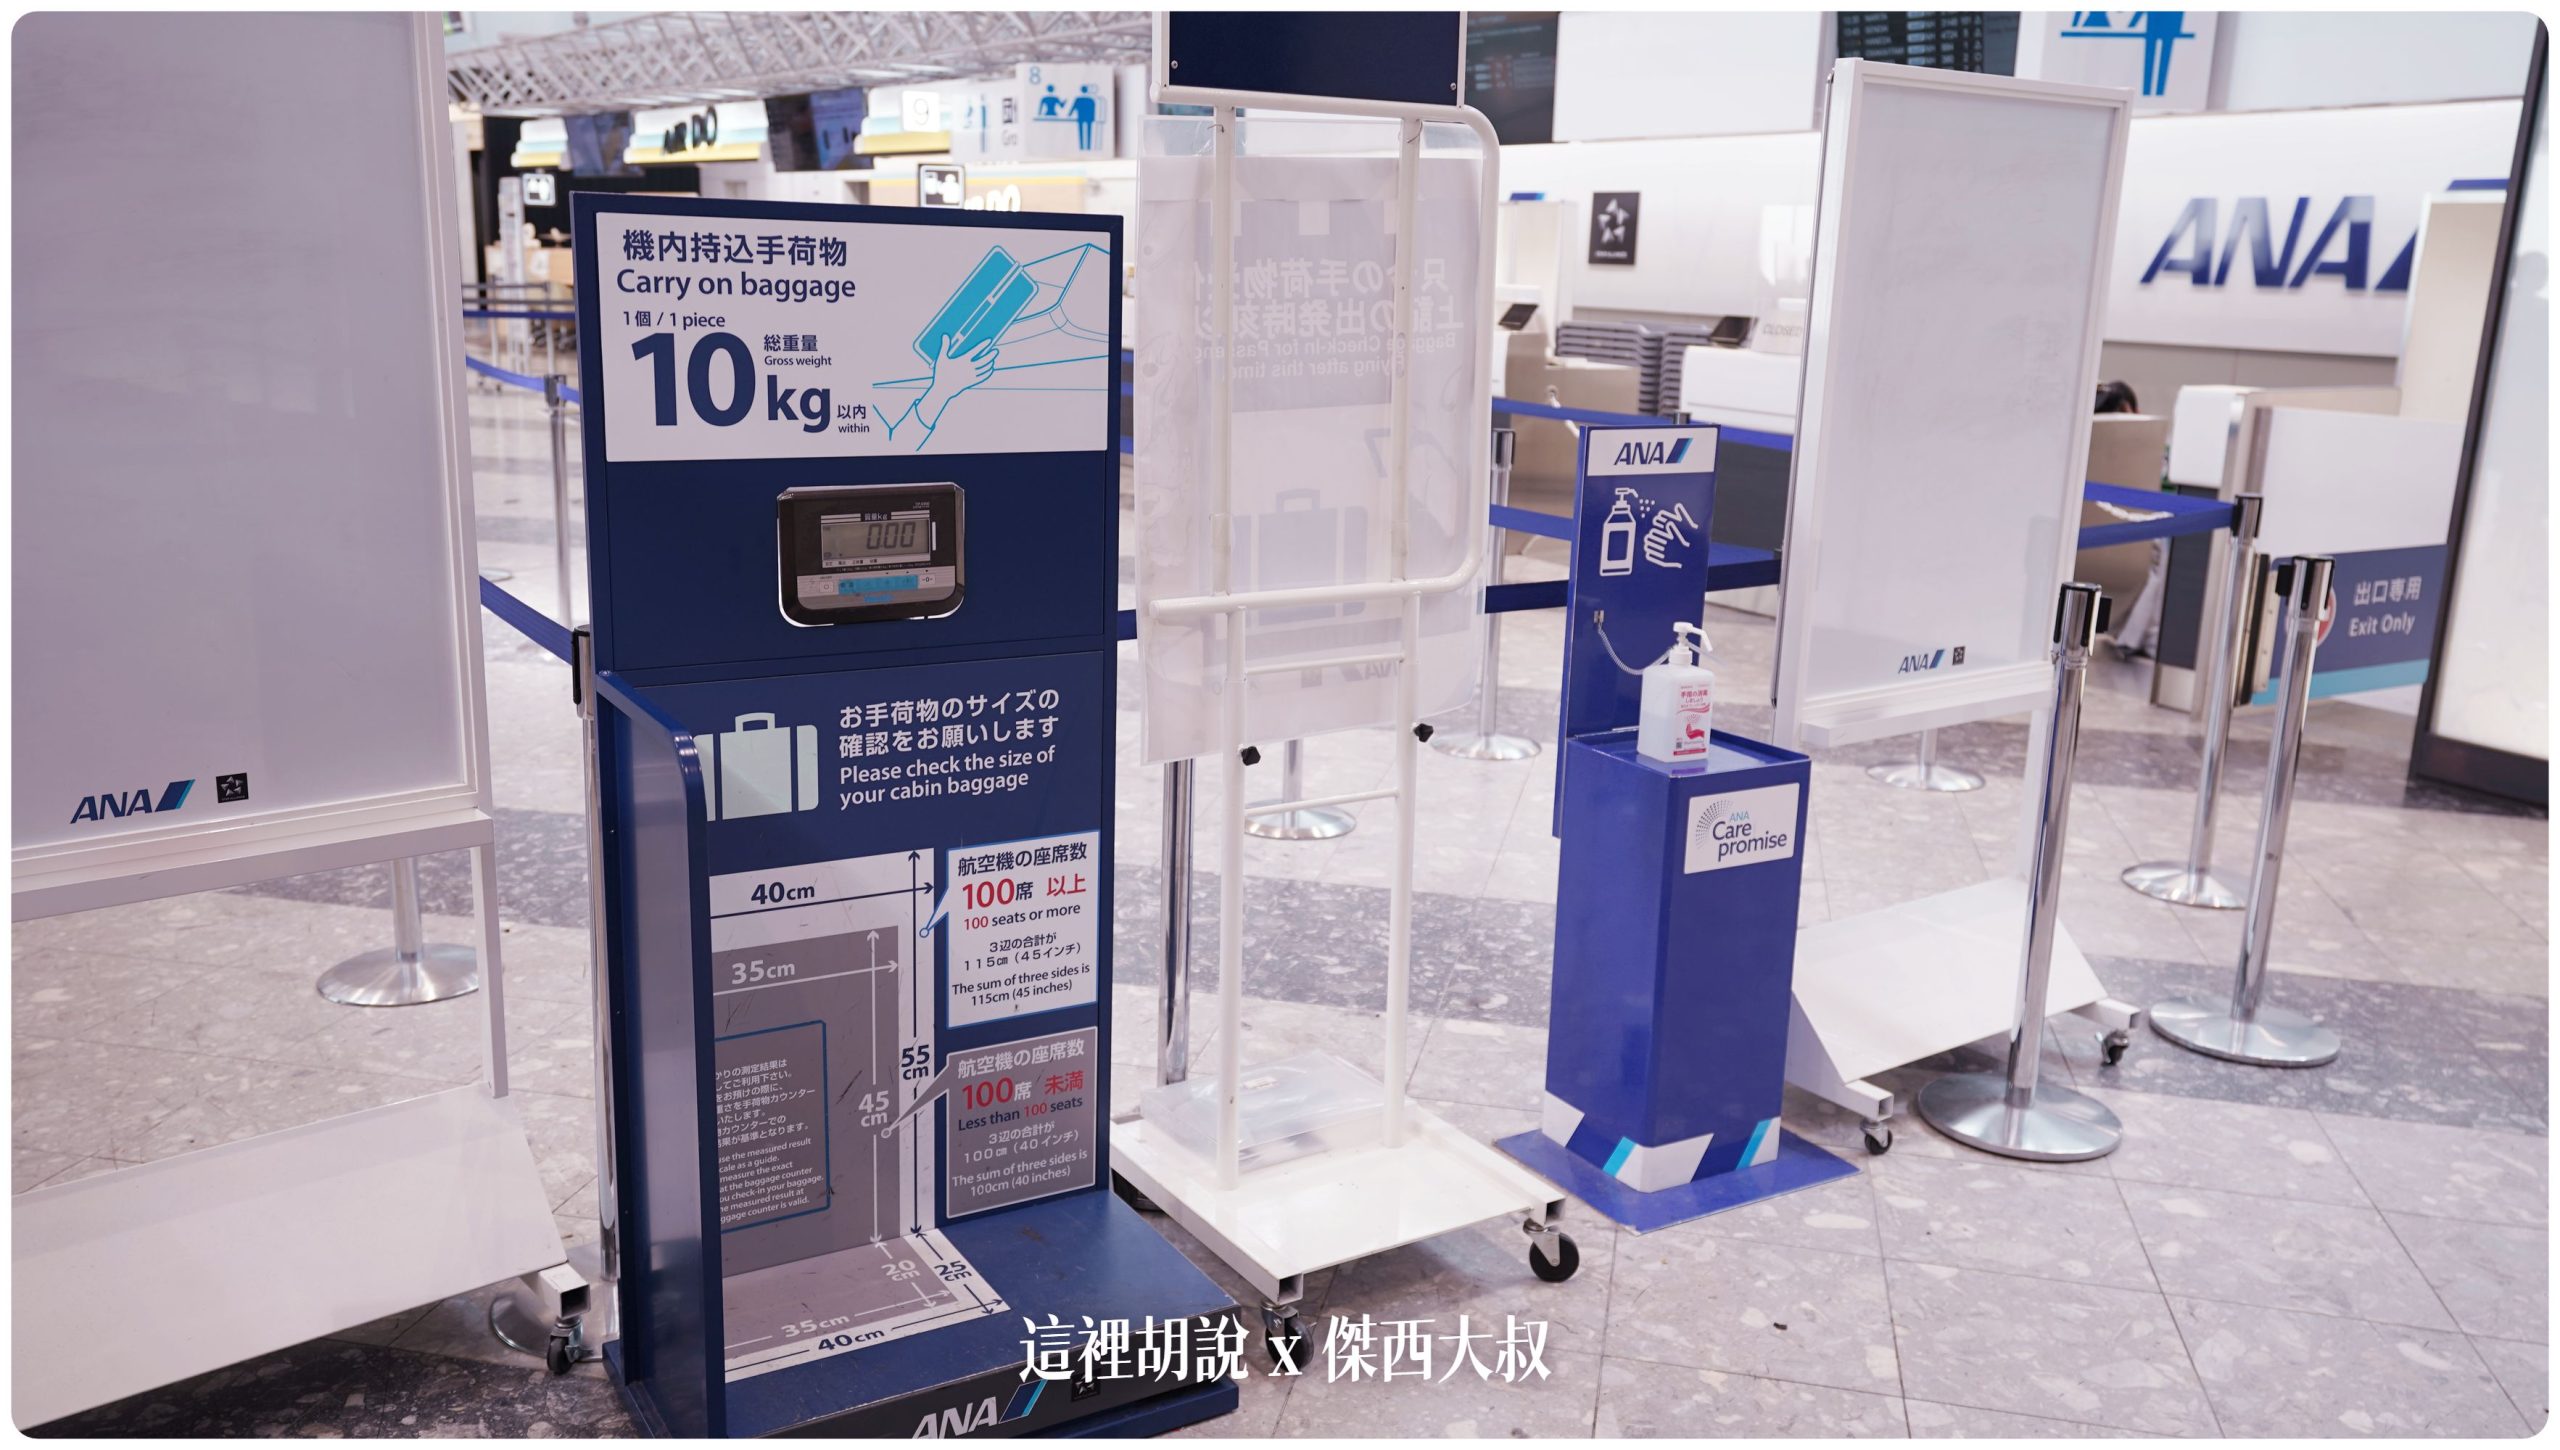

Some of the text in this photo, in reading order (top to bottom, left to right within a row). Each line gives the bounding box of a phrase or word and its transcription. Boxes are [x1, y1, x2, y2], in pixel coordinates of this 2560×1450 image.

[1029, 66, 1042, 85] 8
[623, 229, 847, 267] 機内持込手荷物
[2140, 195, 2374, 290] ANA
[617, 269, 856, 303] Carry on baggage
[683, 312, 726, 330] piece
[763, 334, 818, 352] 総重量
[764, 355, 832, 368] Gross weight
[837, 404, 867, 420] 以内
[838, 423, 870, 433] within
[1613, 441, 1664, 465] ANA
[2354, 576, 2422, 606] 出口専用
[2349, 611, 2416, 637] Exit Only
[1898, 653, 1928, 672] ANA
[839, 689, 1059, 729] お手荷物のサイズの
[839, 715, 1059, 759] 確認をお願いします
[840, 745, 1056, 785] Please check the size of
[840, 771, 1029, 811] your cabin baggage
[70, 789, 152, 824] ANA
[1730, 811, 1750, 822] ANA
[1712, 821, 1752, 841] Care
[1718, 830, 1788, 862] promise
[958, 842, 1087, 876] 航空機の座席数
[751, 882, 815, 905] 40cm
[1046, 873, 1086, 897] 以上
[964, 905, 1080, 930] 100 seats or more
[990, 932, 1057, 952] 3辺の合計が
[731, 960, 795, 984] 35cm
[953, 963, 1090, 995] The sum of three sides is
[972, 980, 1072, 1006] 115cm (45 inches)
[901, 1045, 930, 1068] 55
[958, 1038, 1085, 1079] 航空機の座席数
[903, 1066, 929, 1080] cm
[1044, 1070, 1084, 1096] 未満
[858, 1090, 889, 1113] 45
[861, 1112, 888, 1127] cm
[958, 1097, 1083, 1131] Less than 100 seats
[989, 1121, 1055, 1145] 3辺の合計が
[732, 1152, 746, 1160] the
[747, 1143, 787, 1158] measured
[788, 1138, 812, 1149] result
[753, 1154, 780, 1167] guide.
[719, 1161, 793, 1183] measure the exact
[729, 1182, 743, 1191] the
[744, 1174, 780, 1188] baggage
[781, 1167, 813, 1179] counter
[952, 1149, 1087, 1187] The sum of three sides is
[731, 1186, 766, 1200] check-in
[766, 1183, 785, 1194] your
[786, 1175, 824, 1188] baggage.
[970, 1166, 1071, 1197] 100cm (40 inches)
[730, 1195, 771, 1210] measured
[772, 1190, 795, 1201] result
[796, 1188, 804, 1196] at
[747, 1203, 779, 1216] counter
[780, 1201, 787, 1209] is
[788, 1196, 810, 1207] valid.
[881, 1259, 917, 1277] 20
[892, 1268, 920, 1282] cm
[934, 1260, 966, 1276] 25
[943, 1267, 973, 1282] cm
[781, 1314, 850, 1338] 35cm
[817, 1328, 885, 1352] 40cm
[912, 1397, 998, 1439] ANA
